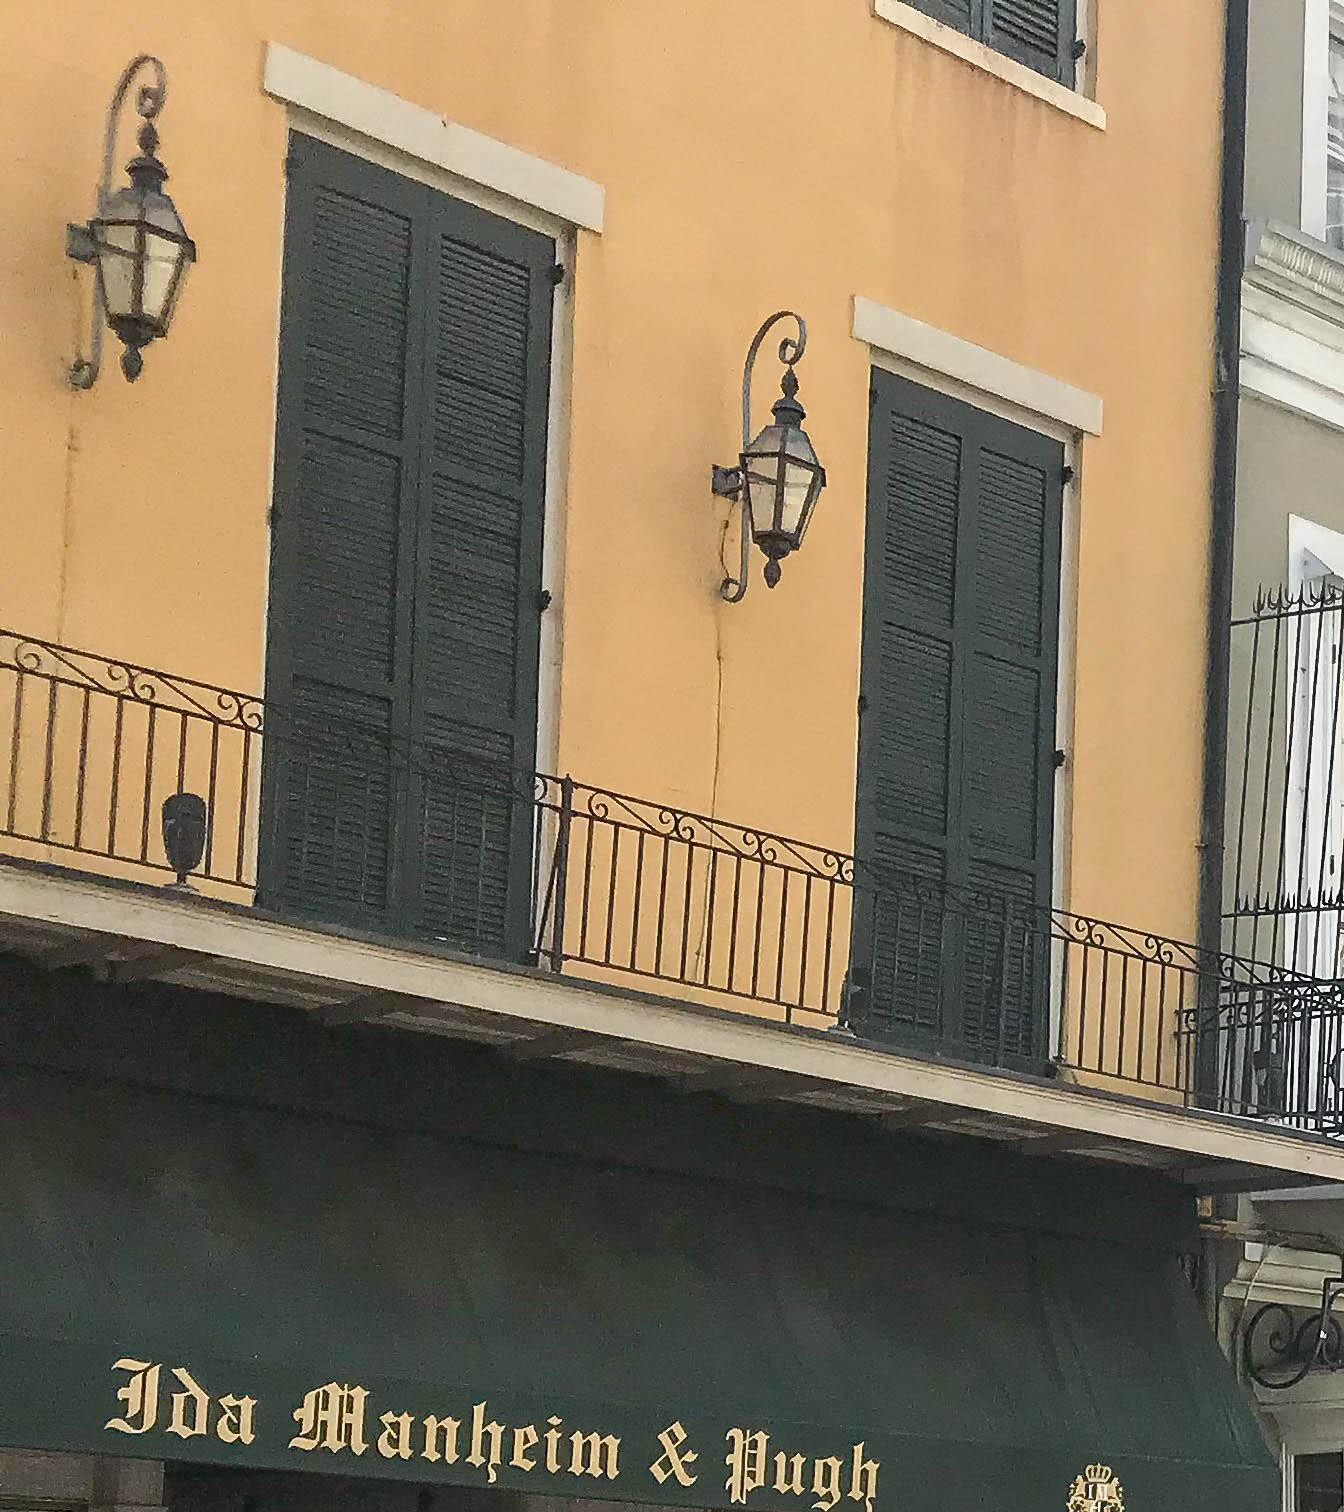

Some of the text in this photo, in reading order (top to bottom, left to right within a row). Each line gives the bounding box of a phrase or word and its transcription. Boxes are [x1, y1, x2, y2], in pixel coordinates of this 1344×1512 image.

[104, 1358, 258, 1445] Ida
[288, 1381, 622, 1484] Manheim
[648, 1420, 699, 1488] &
